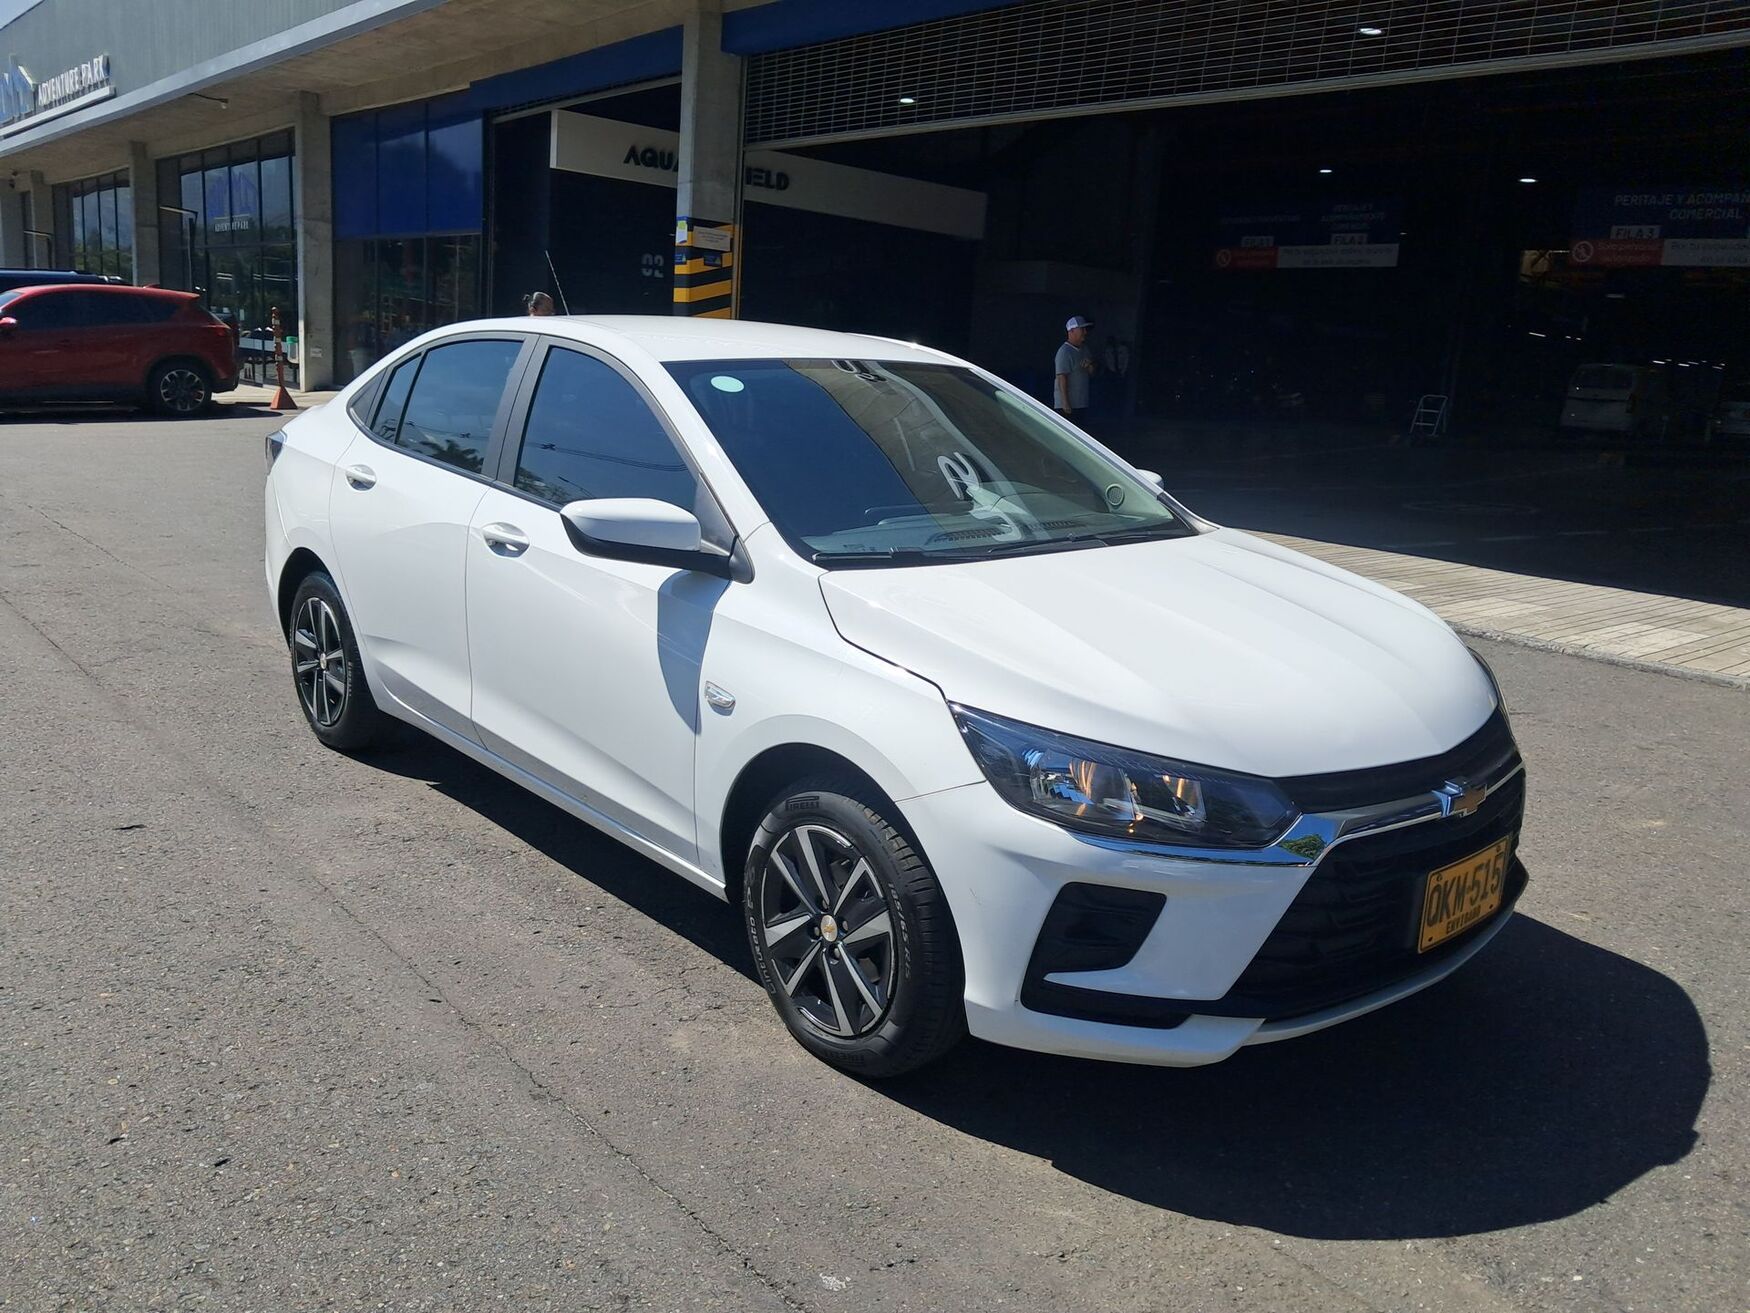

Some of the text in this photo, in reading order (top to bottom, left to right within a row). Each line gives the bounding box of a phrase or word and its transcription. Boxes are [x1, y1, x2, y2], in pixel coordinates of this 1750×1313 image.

[38, 54, 105, 106] ADVENTURE PARK
[1426, 851, 1505, 927] OKM-515
